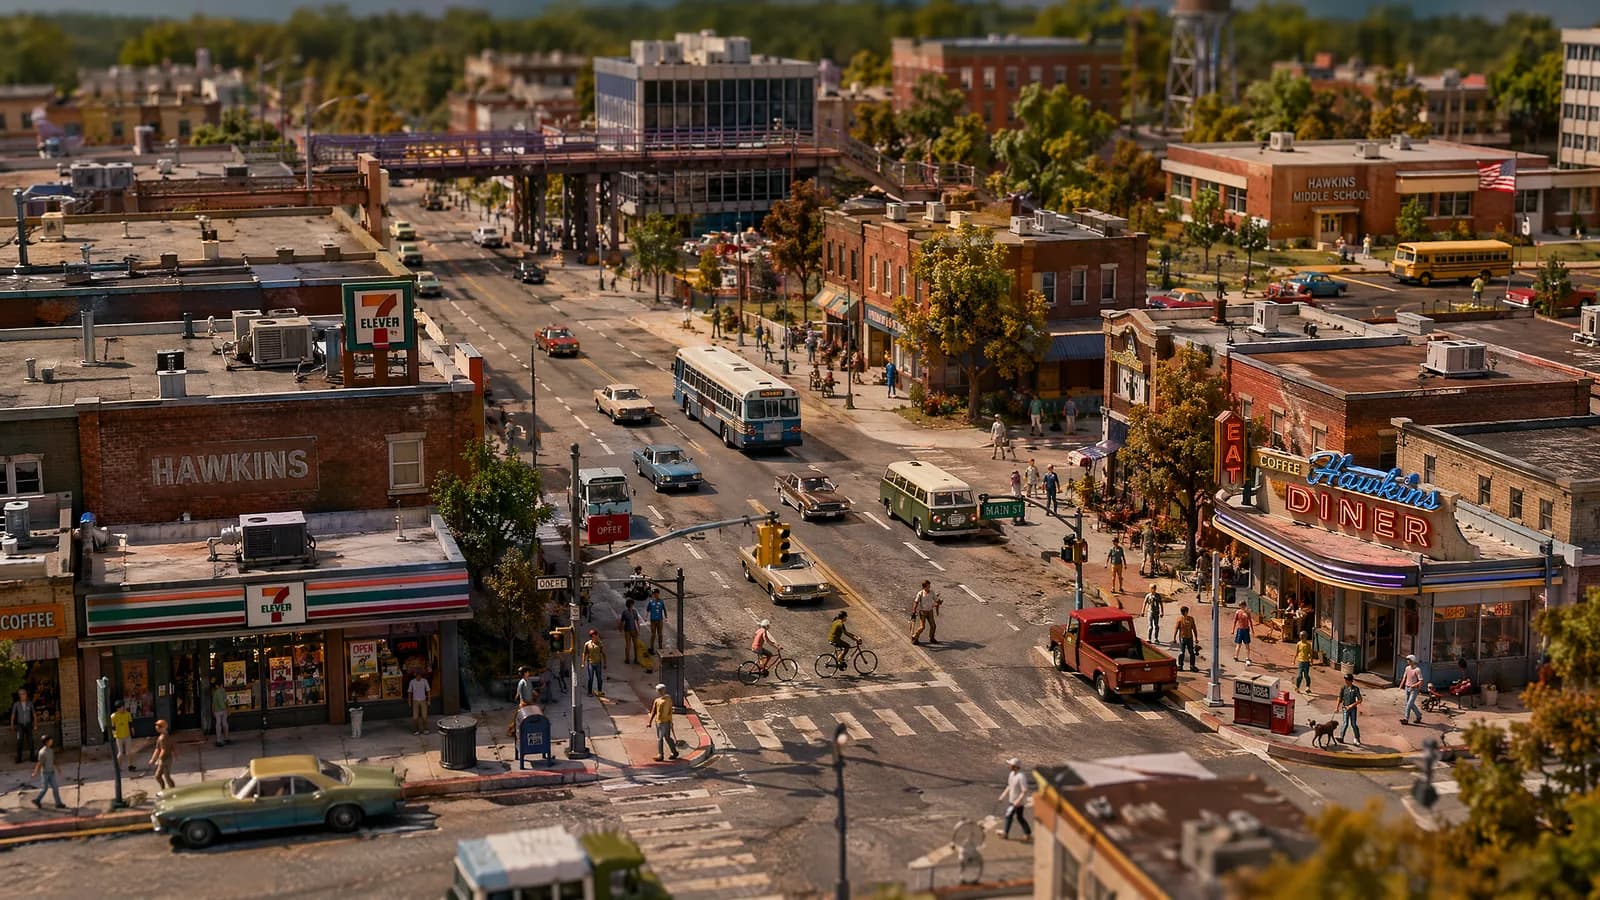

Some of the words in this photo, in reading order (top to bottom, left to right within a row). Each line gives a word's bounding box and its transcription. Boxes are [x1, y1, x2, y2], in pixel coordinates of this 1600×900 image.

[1293, 191, 1329, 202] MIDDLE
[1333, 190, 1371, 201] SCHOOL
[1308, 176, 1356, 189] HAWKINS
[361, 294, 397, 346] 7
[151, 448, 309, 486] HAWKINS
[1225, 423, 1242, 484] EAT
[1260, 455, 1300, 476] COFFEE
[1306, 451, 1441, 511] Hawkins
[986, 505, 1009, 515] MAIN
[1012, 504, 1022, 513] ST
[1286, 484, 1431, 547] DINER
[261, 586, 290, 623] 7
[0, 612, 55, 630] COFFEE
[352, 643, 374, 654] OPEN
